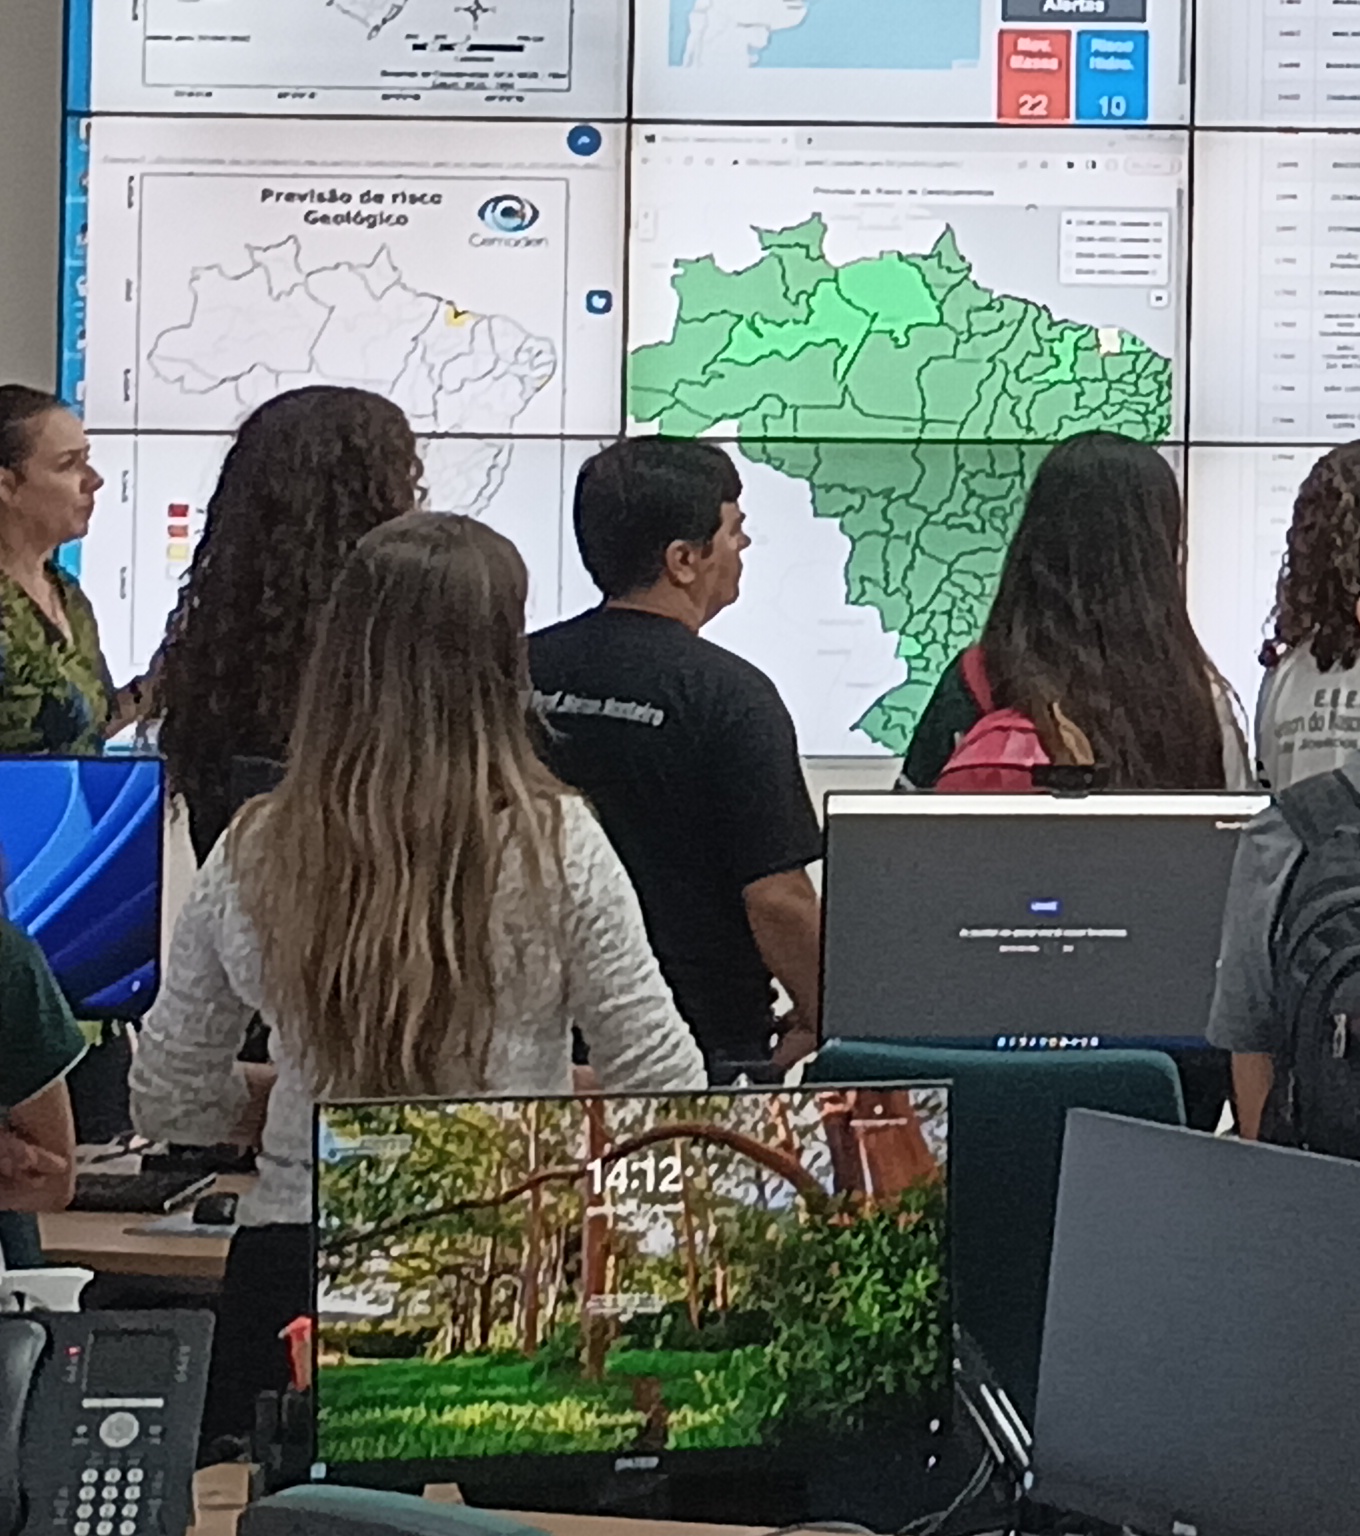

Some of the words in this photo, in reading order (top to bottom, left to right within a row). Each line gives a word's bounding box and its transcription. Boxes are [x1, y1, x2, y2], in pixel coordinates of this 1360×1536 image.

[1018, 93, 1048, 116] 22
[1098, 95, 1127, 117] 10
[261, 188, 352, 204] Previsão
[359, 189, 384, 205] de
[391, 189, 443, 205] risco
[303, 209, 409, 229] Geológico
[586, 1154, 683, 1195] 14:12
